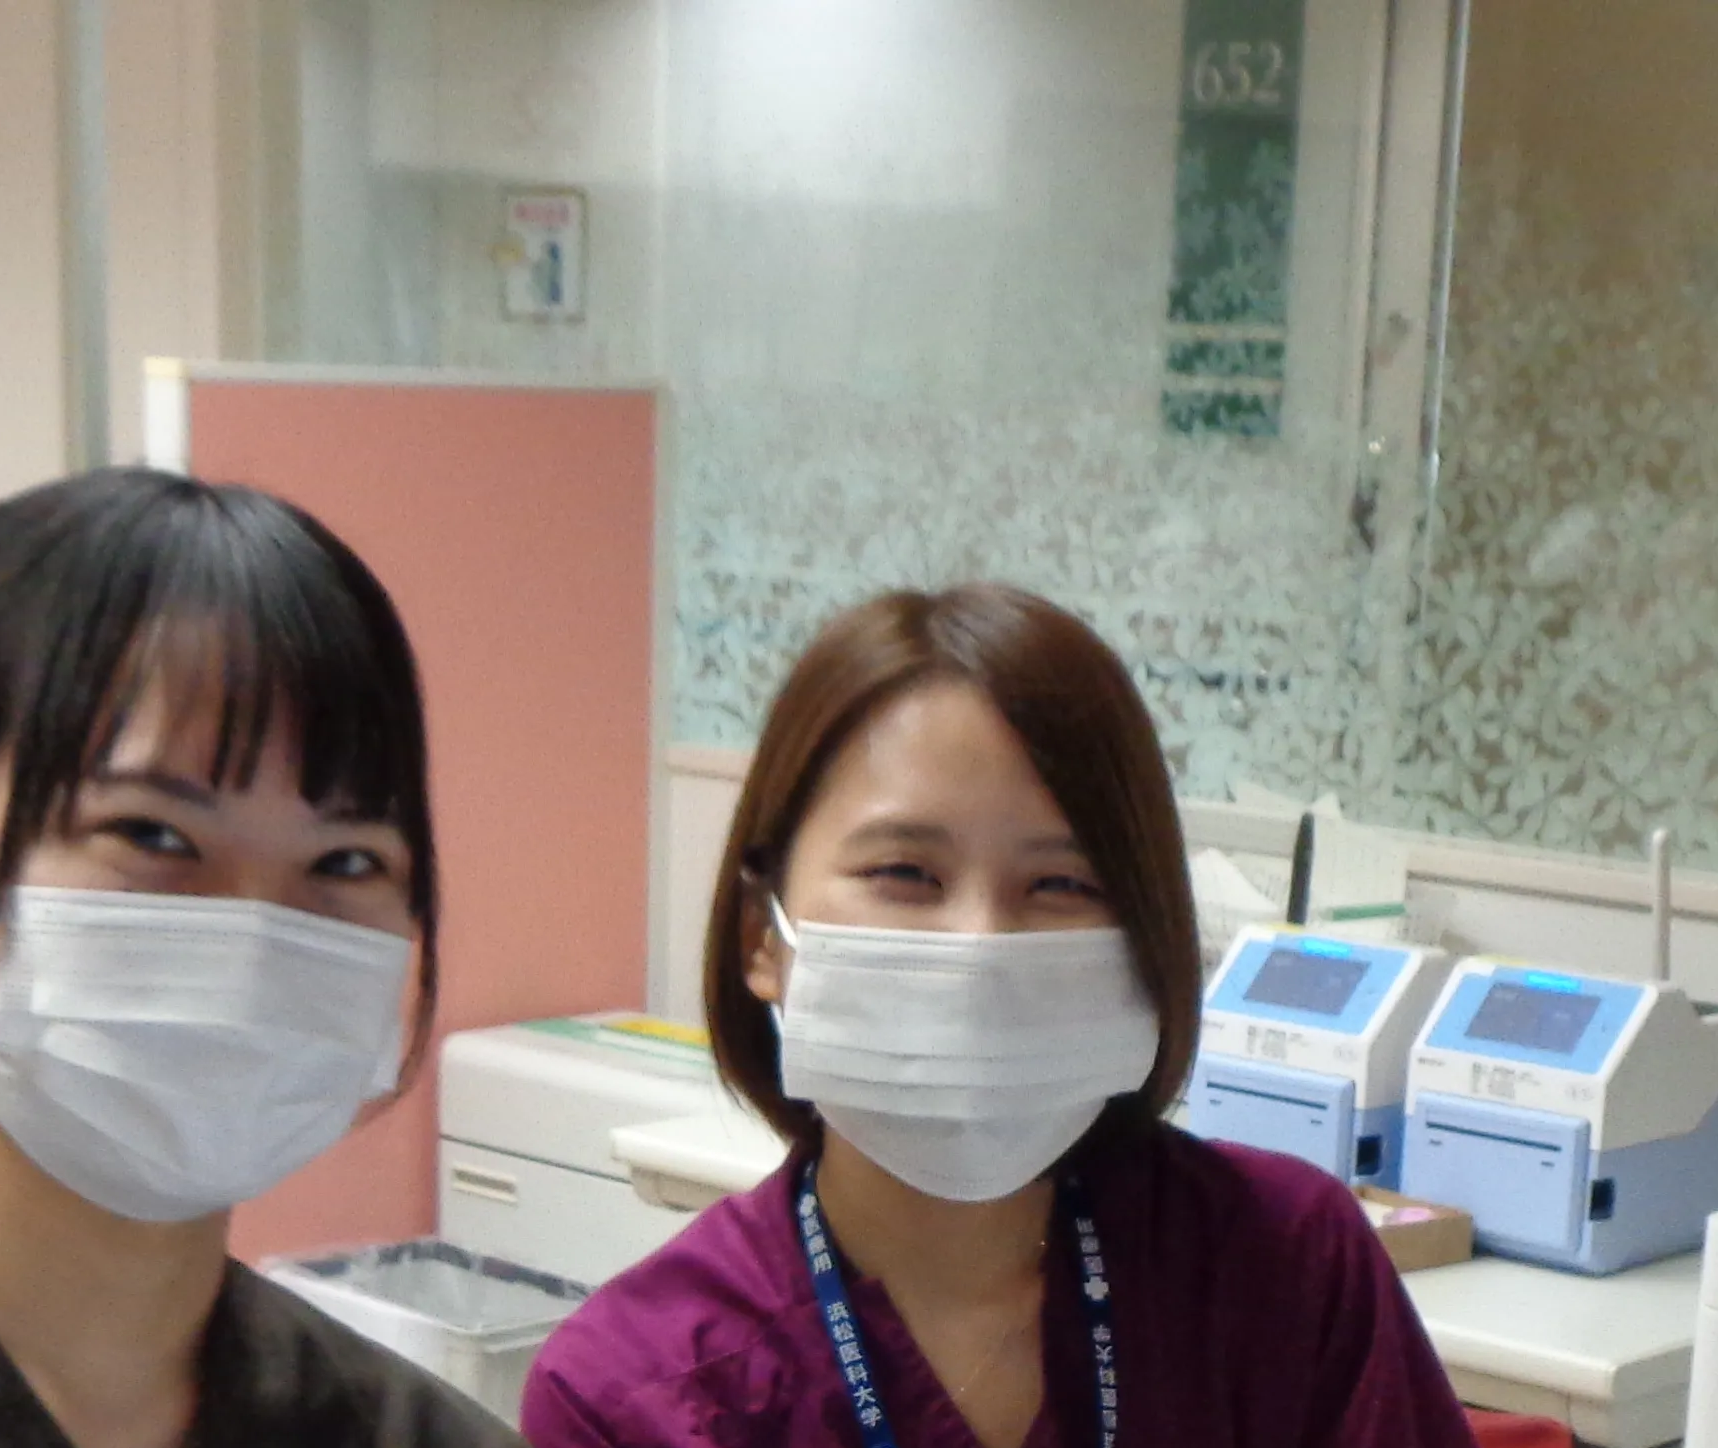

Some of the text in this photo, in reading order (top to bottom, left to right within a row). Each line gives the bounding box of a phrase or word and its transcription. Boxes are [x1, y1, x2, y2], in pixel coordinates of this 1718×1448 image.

[1192, 41, 1283, 102] 652
[826, 1301, 882, 1428] 浜松医科大学
